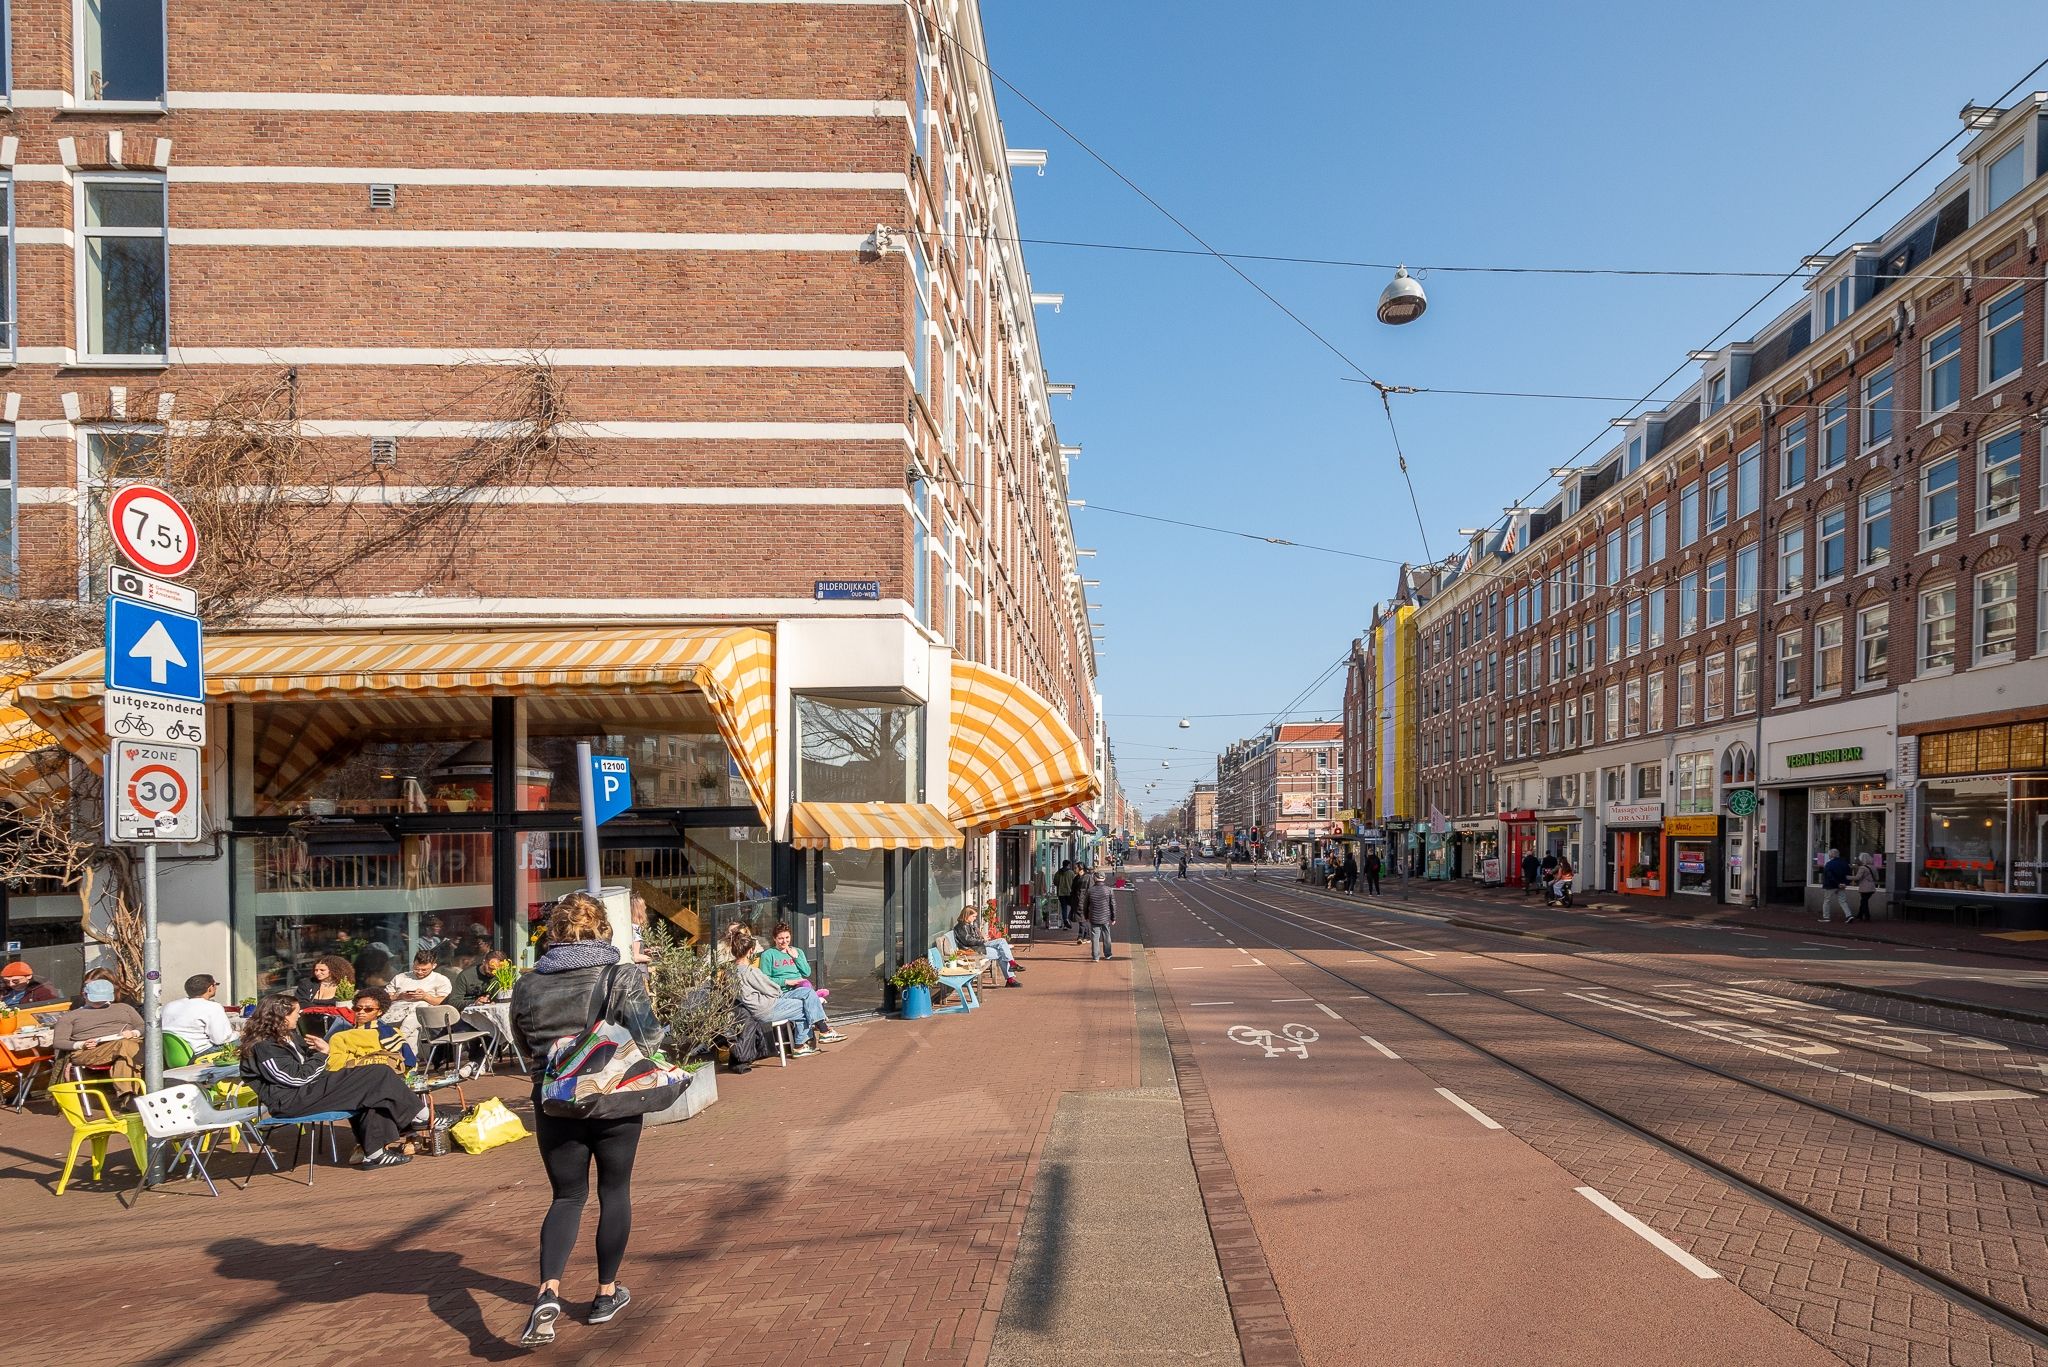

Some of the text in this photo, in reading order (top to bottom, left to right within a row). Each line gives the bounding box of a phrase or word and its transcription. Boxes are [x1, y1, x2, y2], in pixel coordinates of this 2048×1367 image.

[129, 507, 182, 553] 7,5t
[818, 582, 876, 592] BILDERDIJKKADE
[113, 695, 203, 716] uitgezonderd
[141, 749, 177, 761] ZONE
[1786, 747, 1863, 768] VEGAN SUSHI BAR
[603, 762, 625, 770] 12100
[140, 781, 177, 802] 30
[604, 775, 619, 801] P
[2014, 869, 2032, 877] coffee
